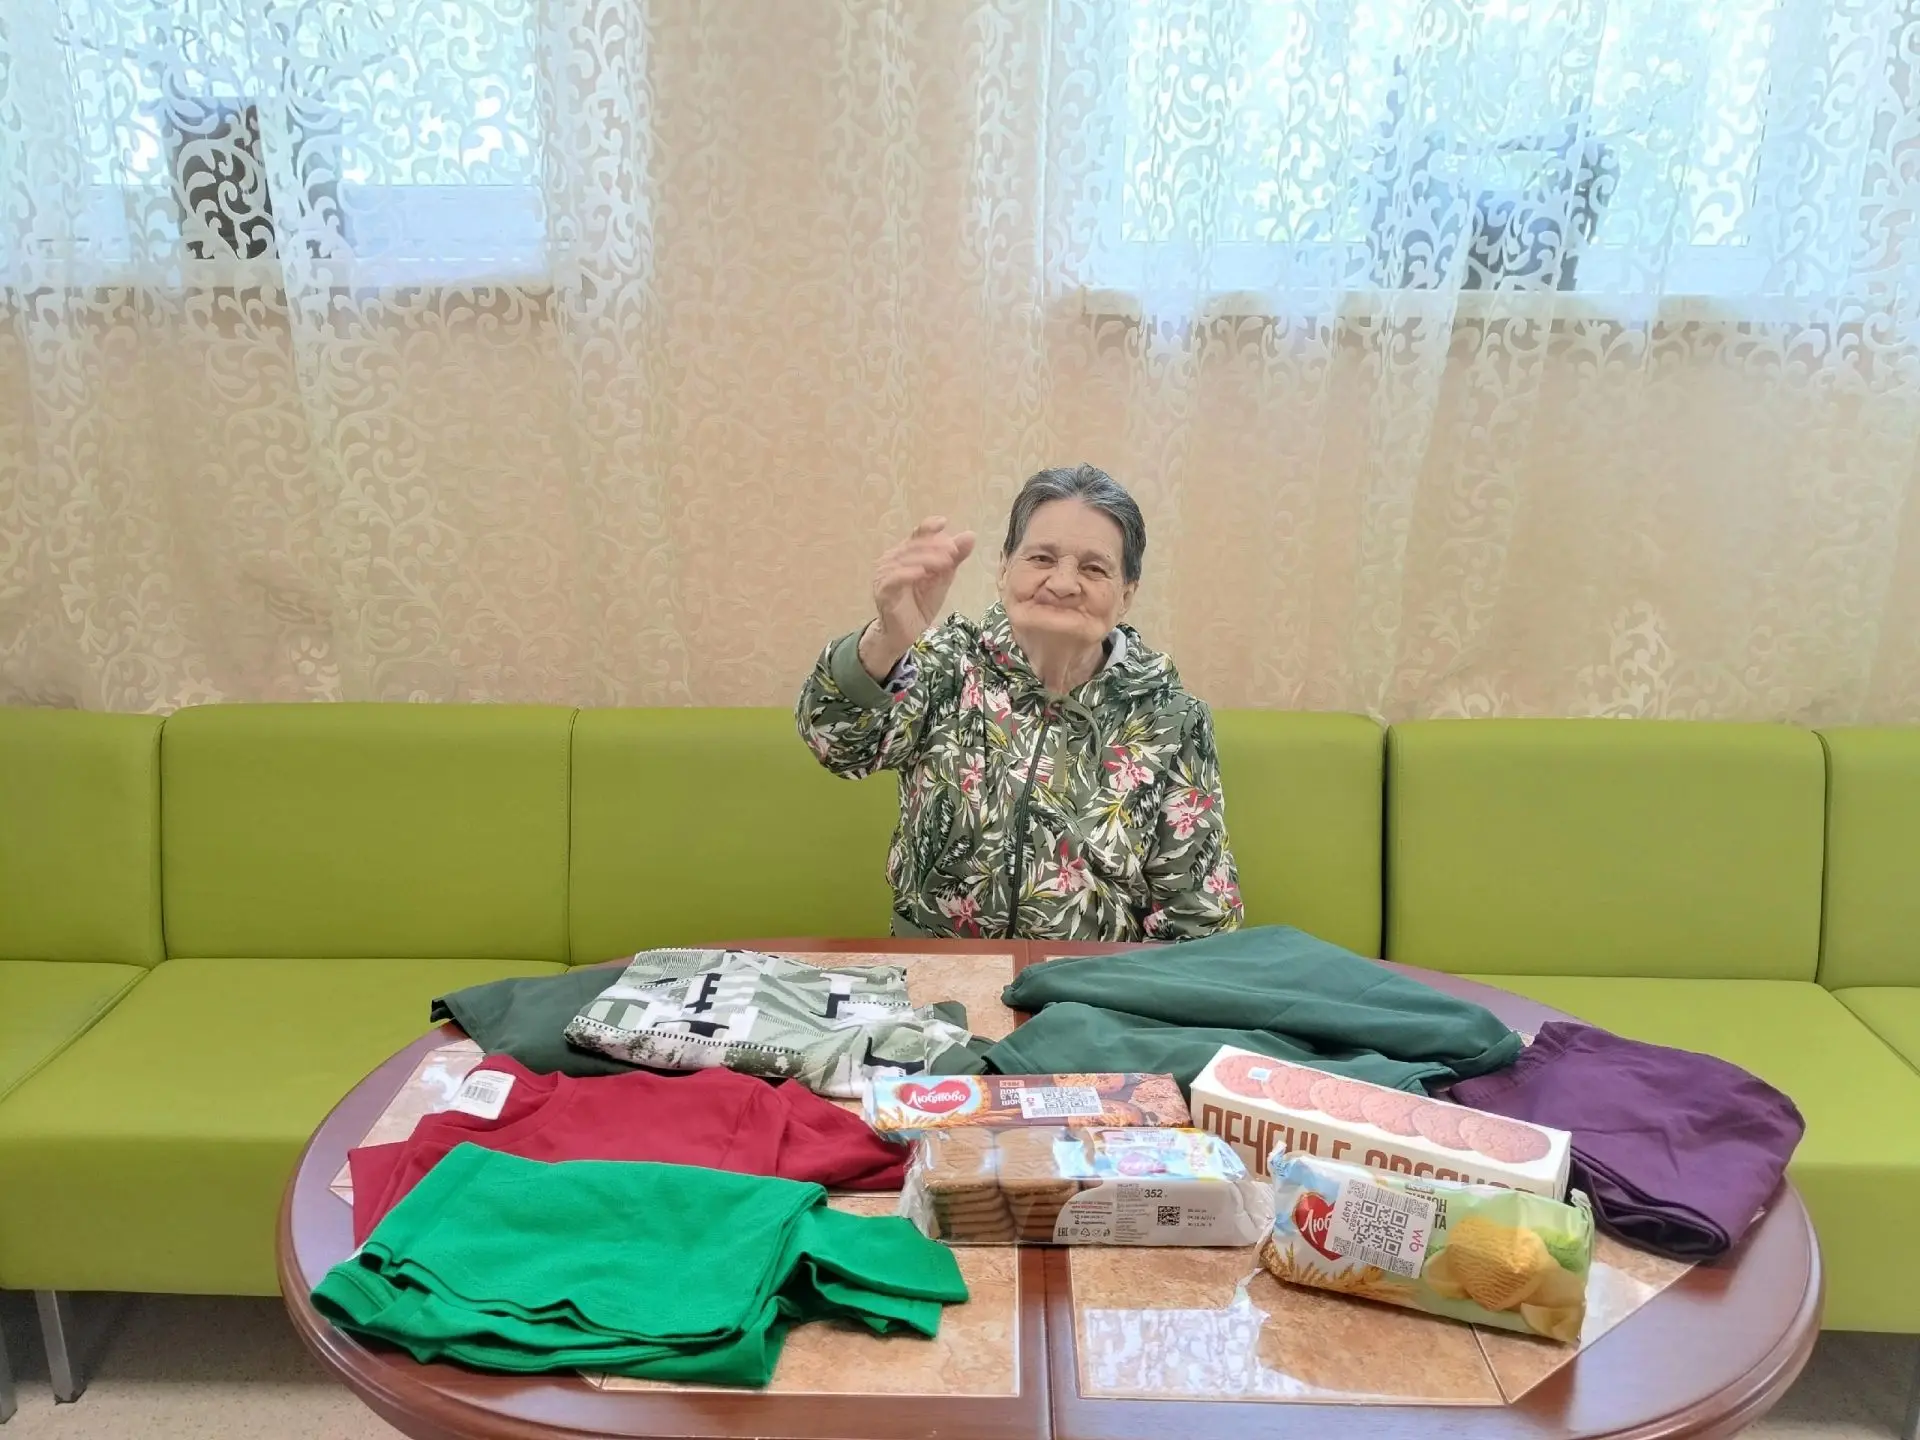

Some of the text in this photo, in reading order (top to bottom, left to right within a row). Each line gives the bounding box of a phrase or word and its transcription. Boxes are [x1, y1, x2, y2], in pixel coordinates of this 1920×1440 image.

[906, 1091, 967, 1109] Любятово
[1144, 1189, 1163, 1199] 352
[1341, 1200, 1354, 1223] 0497
[1434, 1213, 1447, 1230] ТА
[1301, 1208, 1334, 1245] Люб
[1408, 1229, 1425, 1253] wb
